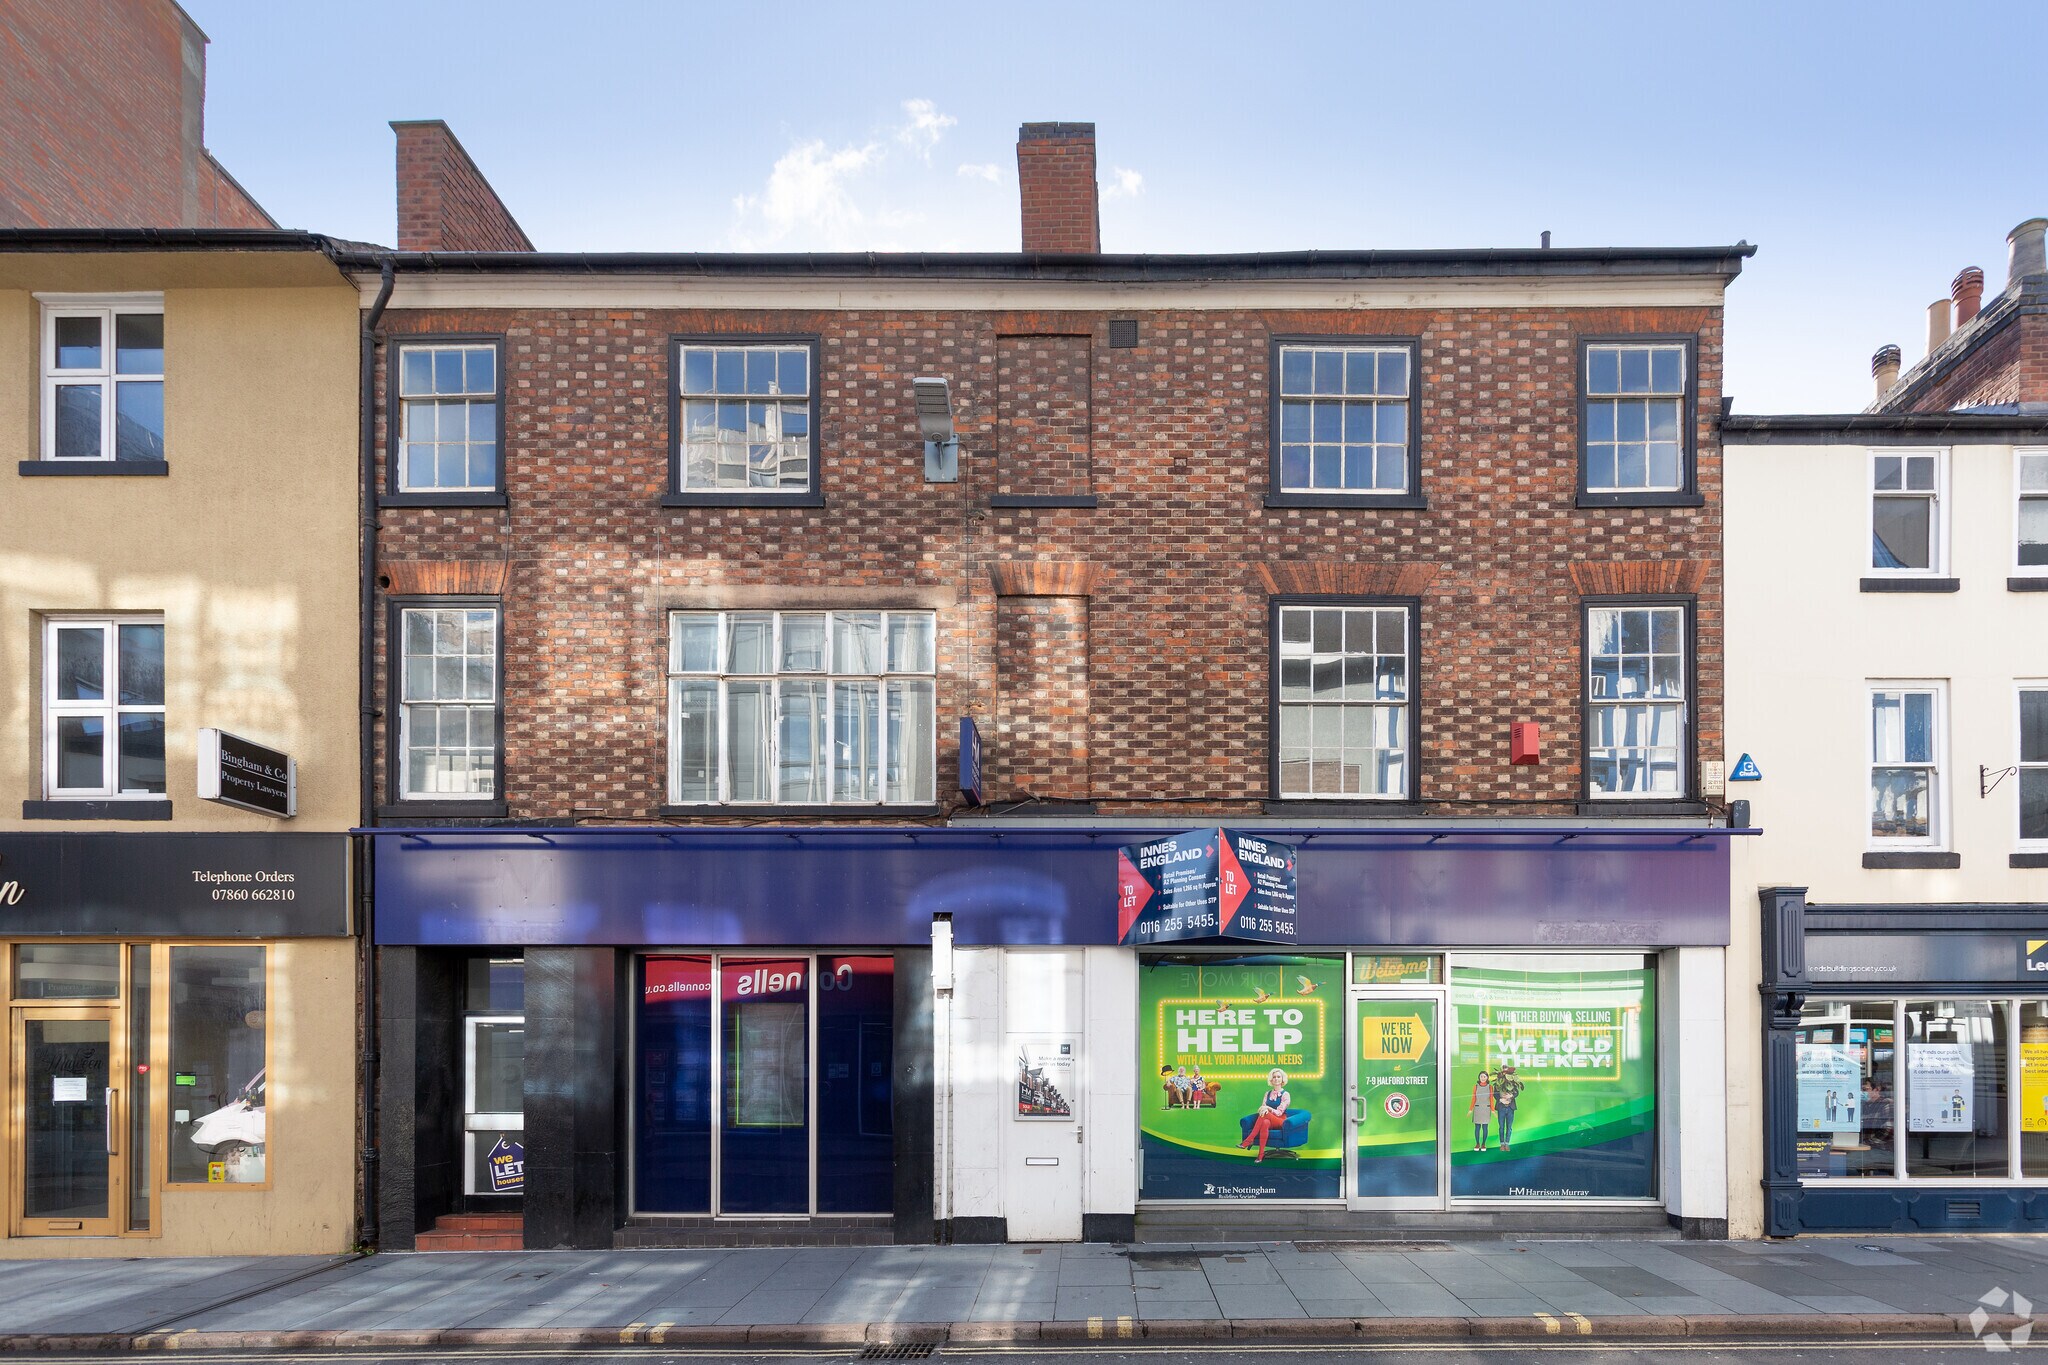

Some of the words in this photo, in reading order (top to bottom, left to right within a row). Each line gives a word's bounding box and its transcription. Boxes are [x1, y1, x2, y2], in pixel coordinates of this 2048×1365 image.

[221, 749, 262, 772] Bingham
[264, 764, 273, 776] &
[274, 767, 287, 781] Co
[221, 770, 255, 790] Property
[256, 781, 287, 798] Lawyers
[1140, 840, 1177, 858] INNES
[1238, 837, 1267, 854] INNES
[1140, 848, 1203, 869] ENGLAND
[1238, 849, 1285, 869] ENGLAND
[192, 870, 252, 885] Telephone
[255, 870, 295, 882] Orders
[1188, 873, 1206, 881] Consent
[1225, 870, 1234, 883] TO
[212, 889, 249, 900] 07860
[251, 889, 295, 900] 662810
[1124, 885, 1133, 896] TO
[1225, 883, 1237, 895] LET
[1123, 896, 1136, 908] LET
[1196, 898, 1207, 906] Uses
[1208, 896, 1217, 904] STP
[1140, 920, 1160, 934] 0116
[1164, 917, 1183, 932] 255
[1187, 913, 1214, 929] 5455
[1240, 915, 1256, 930] 0116
[1259, 918, 1273, 932] 255
[1360, 960, 1428, 980] Welcome
[1807, 964, 1898, 974] leedsbuildingsociety.co.uk
[2026, 958, 2048, 971] Le
[1176, 1008, 1255, 1025] HERE
[1263, 1008, 1304, 1025] TO
[1496, 1011, 1538, 1022] WHETHER
[1540, 1011, 1574, 1023] BUYING,
[1575, 1011, 1611, 1022] SELLING
[1496, 1024, 1543, 1037] LETING
[1177, 1028, 1303, 1052] HELP
[1381, 1037, 1412, 1053] NOW
[1496, 1040, 1537, 1053] WE
[1543, 1040, 1611, 1053] HOLD
[1176, 1055, 1197, 1065] WITH
[1199, 1055, 1212, 1065] ALL
[1214, 1055, 1234, 1065] YOUR
[1236, 1055, 1276, 1065] FINANCIAL
[1278, 1055, 1303, 1065] NEEDS
[1496, 1055, 1548, 1067] THE
[1554, 1055, 1611, 1068] KEY!
[1366, 1076, 1376, 1085] 7-9
[1377, 1076, 1404, 1085] HALFORD
[1405, 1076, 1428, 1085] STREET
[493, 1155, 513, 1164] we
[494, 1161, 524, 1177] LET
[1217, 1186, 1231, 1194] The
[1232, 1186, 1276, 1195] Nottingham
[1509, 1187, 1525, 1196] HM
[1526, 1188, 1560, 1196] Harrison
[1561, 1188, 1590, 1197] Murray
